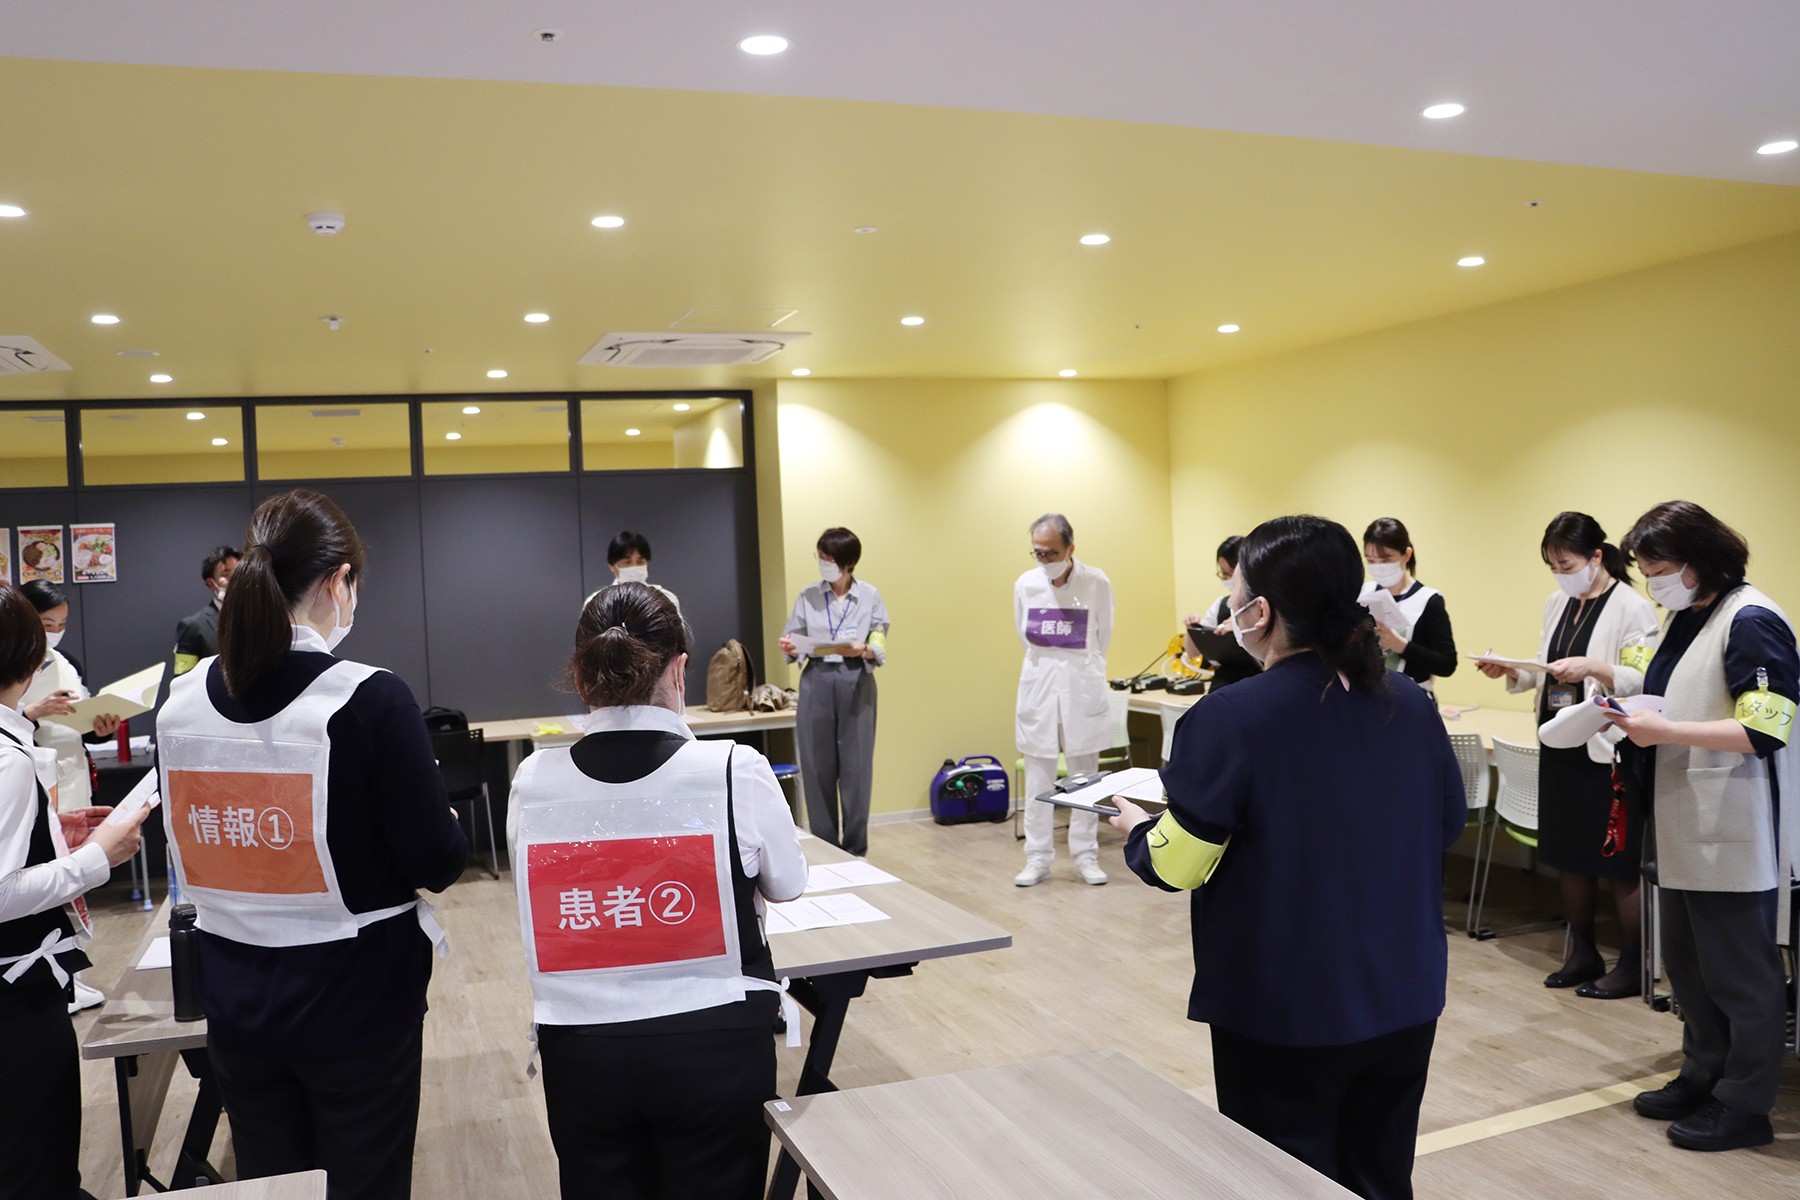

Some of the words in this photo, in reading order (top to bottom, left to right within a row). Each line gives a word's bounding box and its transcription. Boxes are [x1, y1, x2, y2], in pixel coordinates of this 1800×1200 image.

[1041, 620, 1074, 636] 医師
[1737, 700, 1793, 726] スタッフ
[188, 804, 294, 850] 情報①
[558, 880, 696, 930] 患者②
